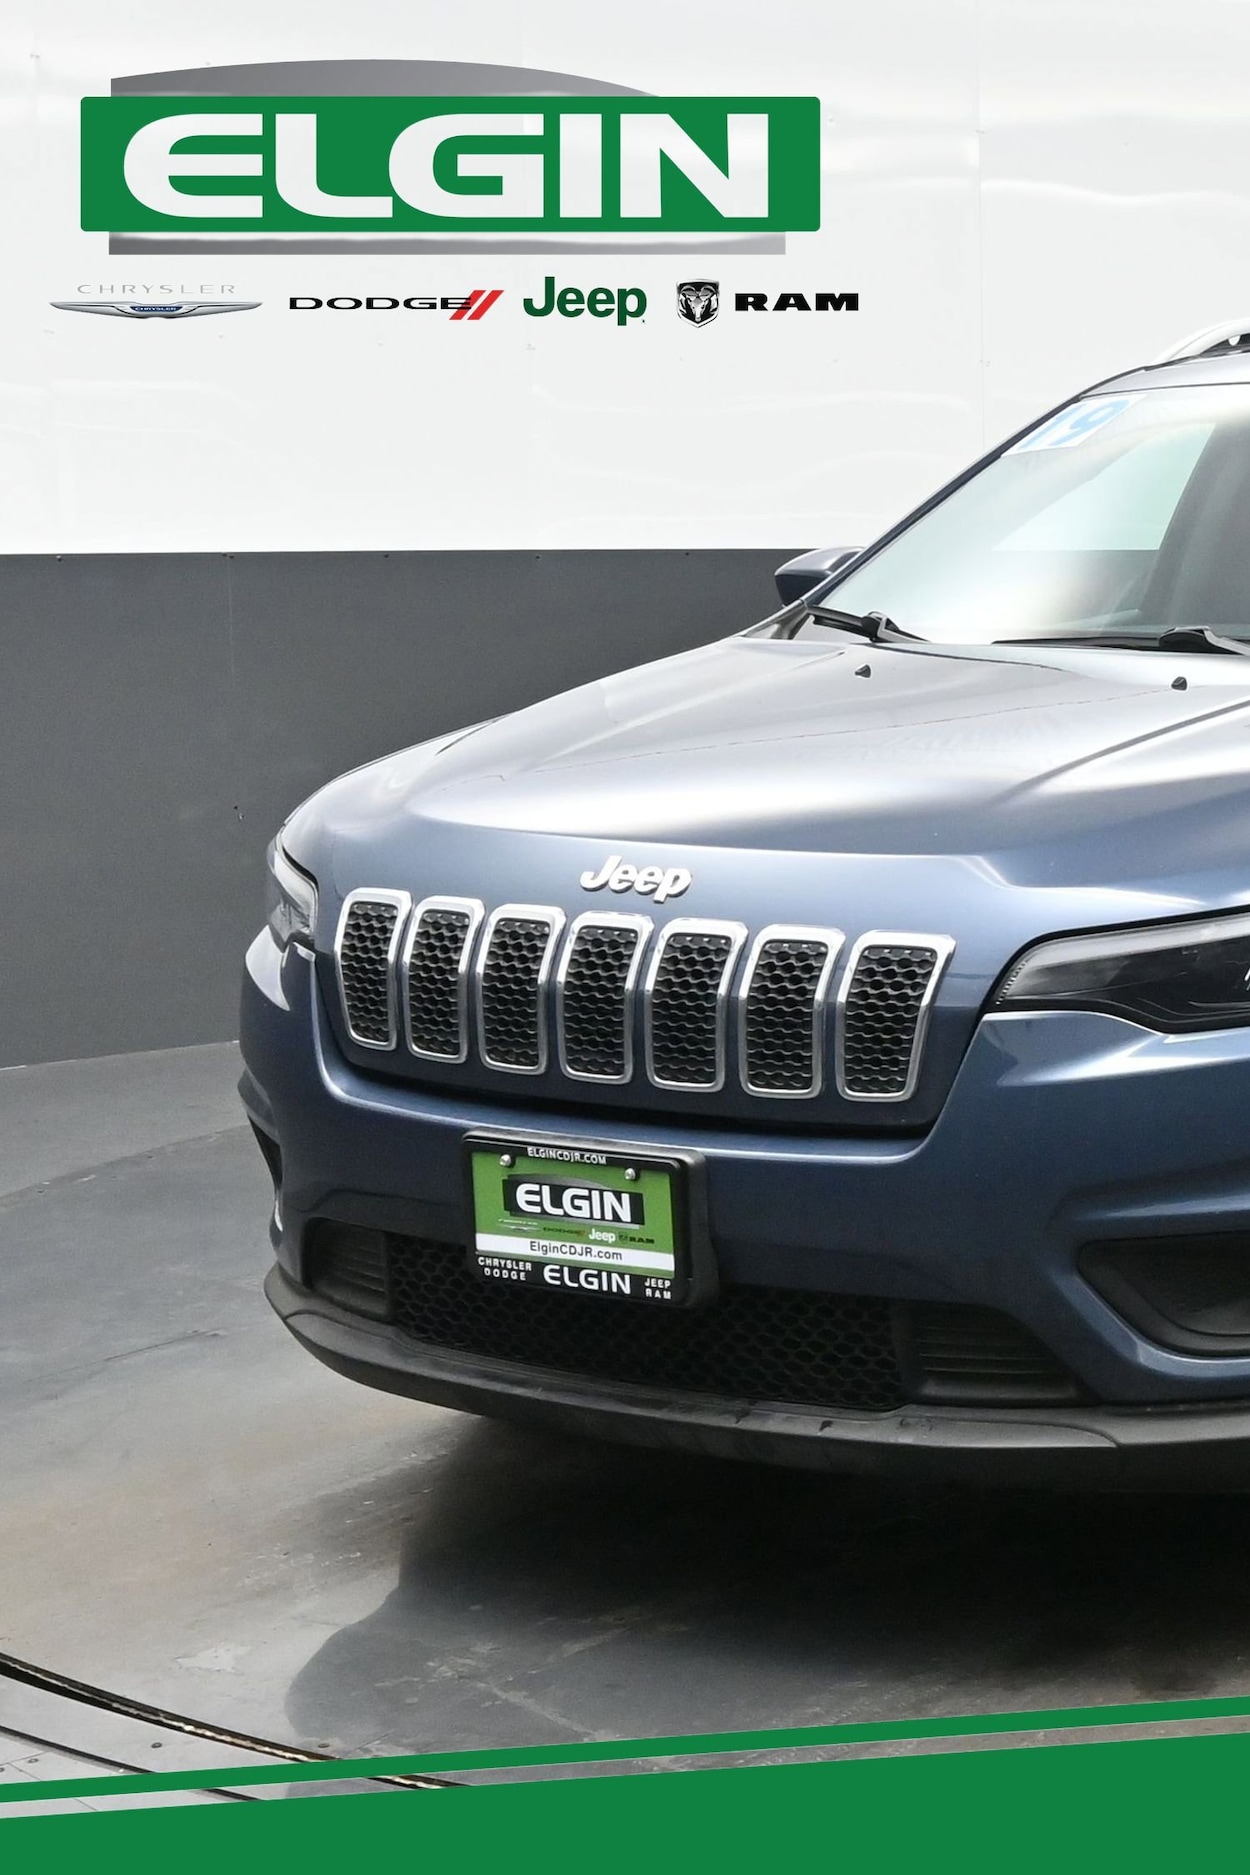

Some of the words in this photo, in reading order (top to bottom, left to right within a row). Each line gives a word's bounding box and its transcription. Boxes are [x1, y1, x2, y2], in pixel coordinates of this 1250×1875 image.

[580, 855, 692, 904] Jeep
[527, 1147, 607, 1165] ELGINCDJR.COM
[516, 1183, 632, 1223] ELGIN
[588, 1228, 616, 1243] Jeep
[629, 1236, 655, 1244] RAM
[530, 1241, 623, 1260] ElginCDJR.com
[477, 1256, 532, 1272] CHRYSLER
[484, 1268, 527, 1281] DODGE
[543, 1264, 632, 1294] ELGIN
[645, 1277, 671, 1288] JEEP
[645, 1288, 671, 1300] RAM
